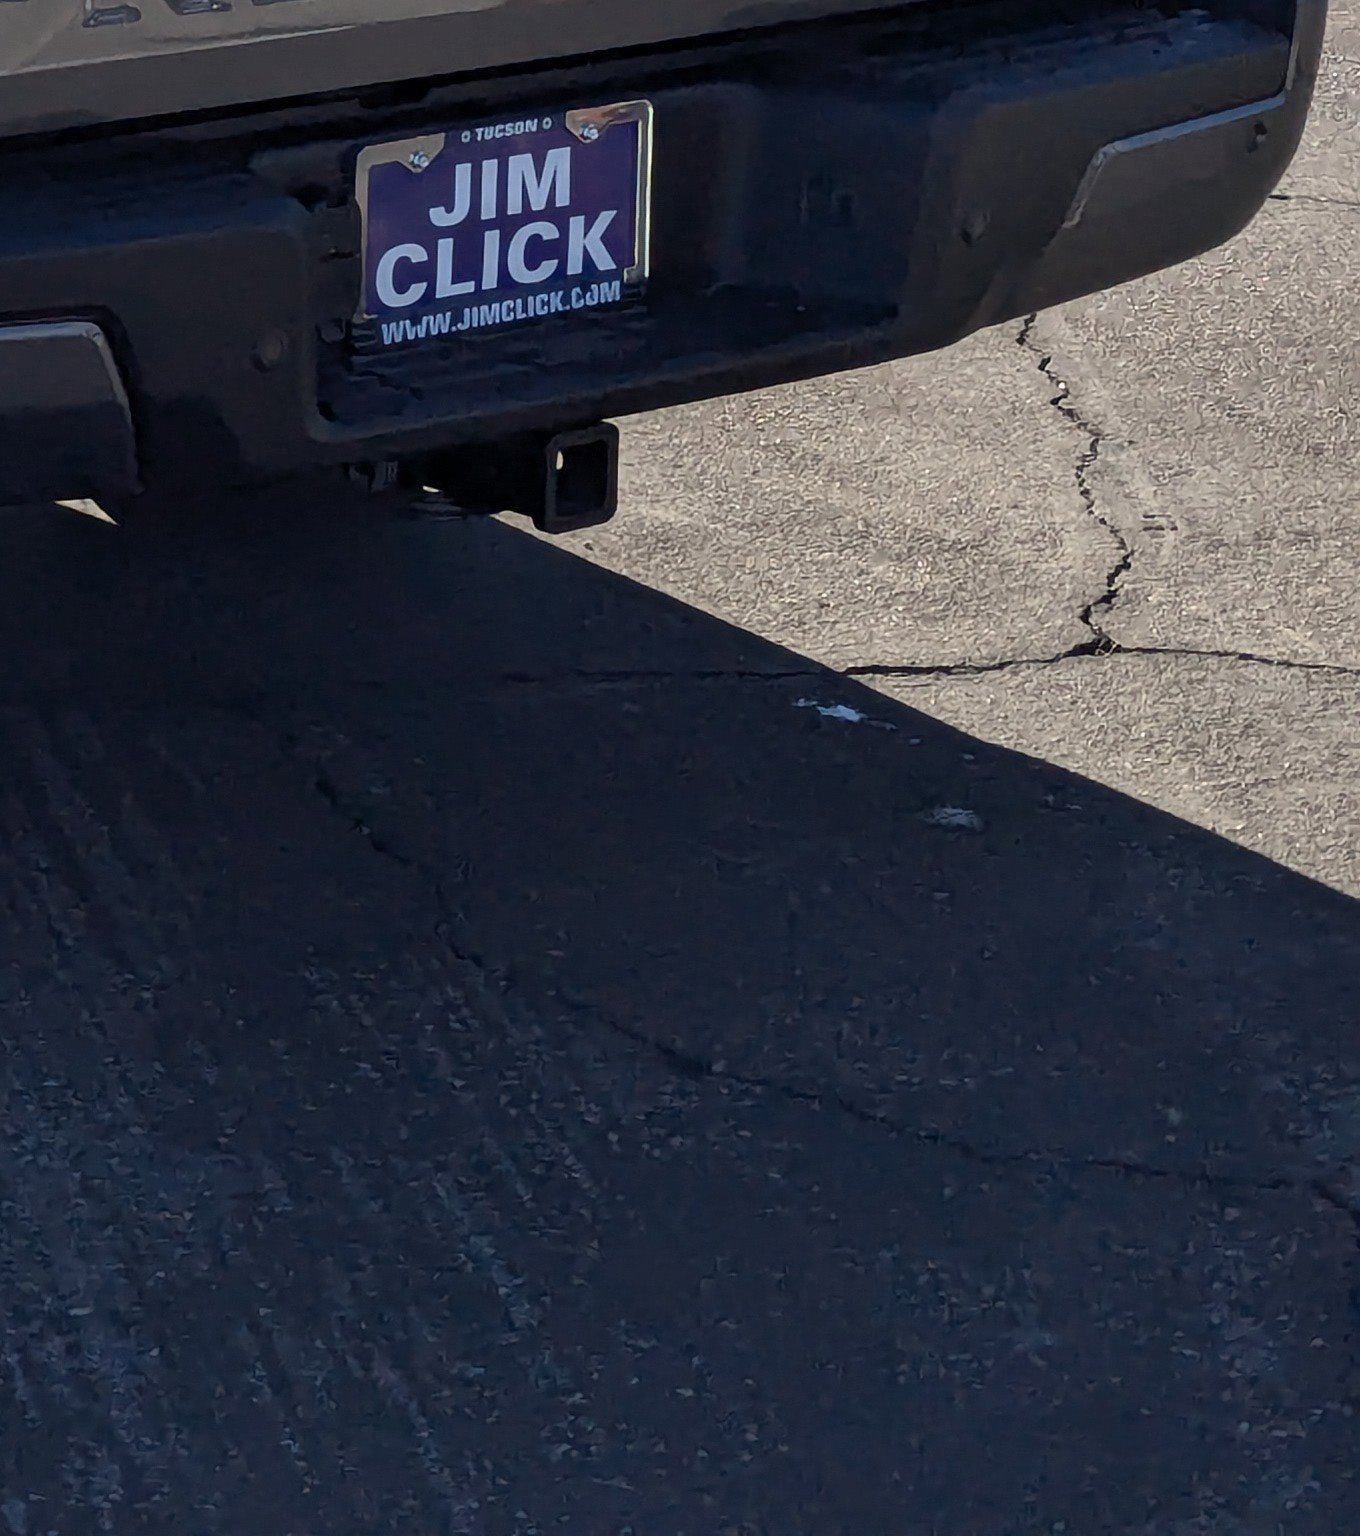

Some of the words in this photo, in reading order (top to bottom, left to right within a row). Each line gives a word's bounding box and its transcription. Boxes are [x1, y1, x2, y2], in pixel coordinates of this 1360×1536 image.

[475, 118, 538, 142] TUCSON
[429, 147, 571, 227] JIM
[376, 210, 618, 307] CLICK
[381, 280, 621, 345] WWW.JIMCLICK.COM
